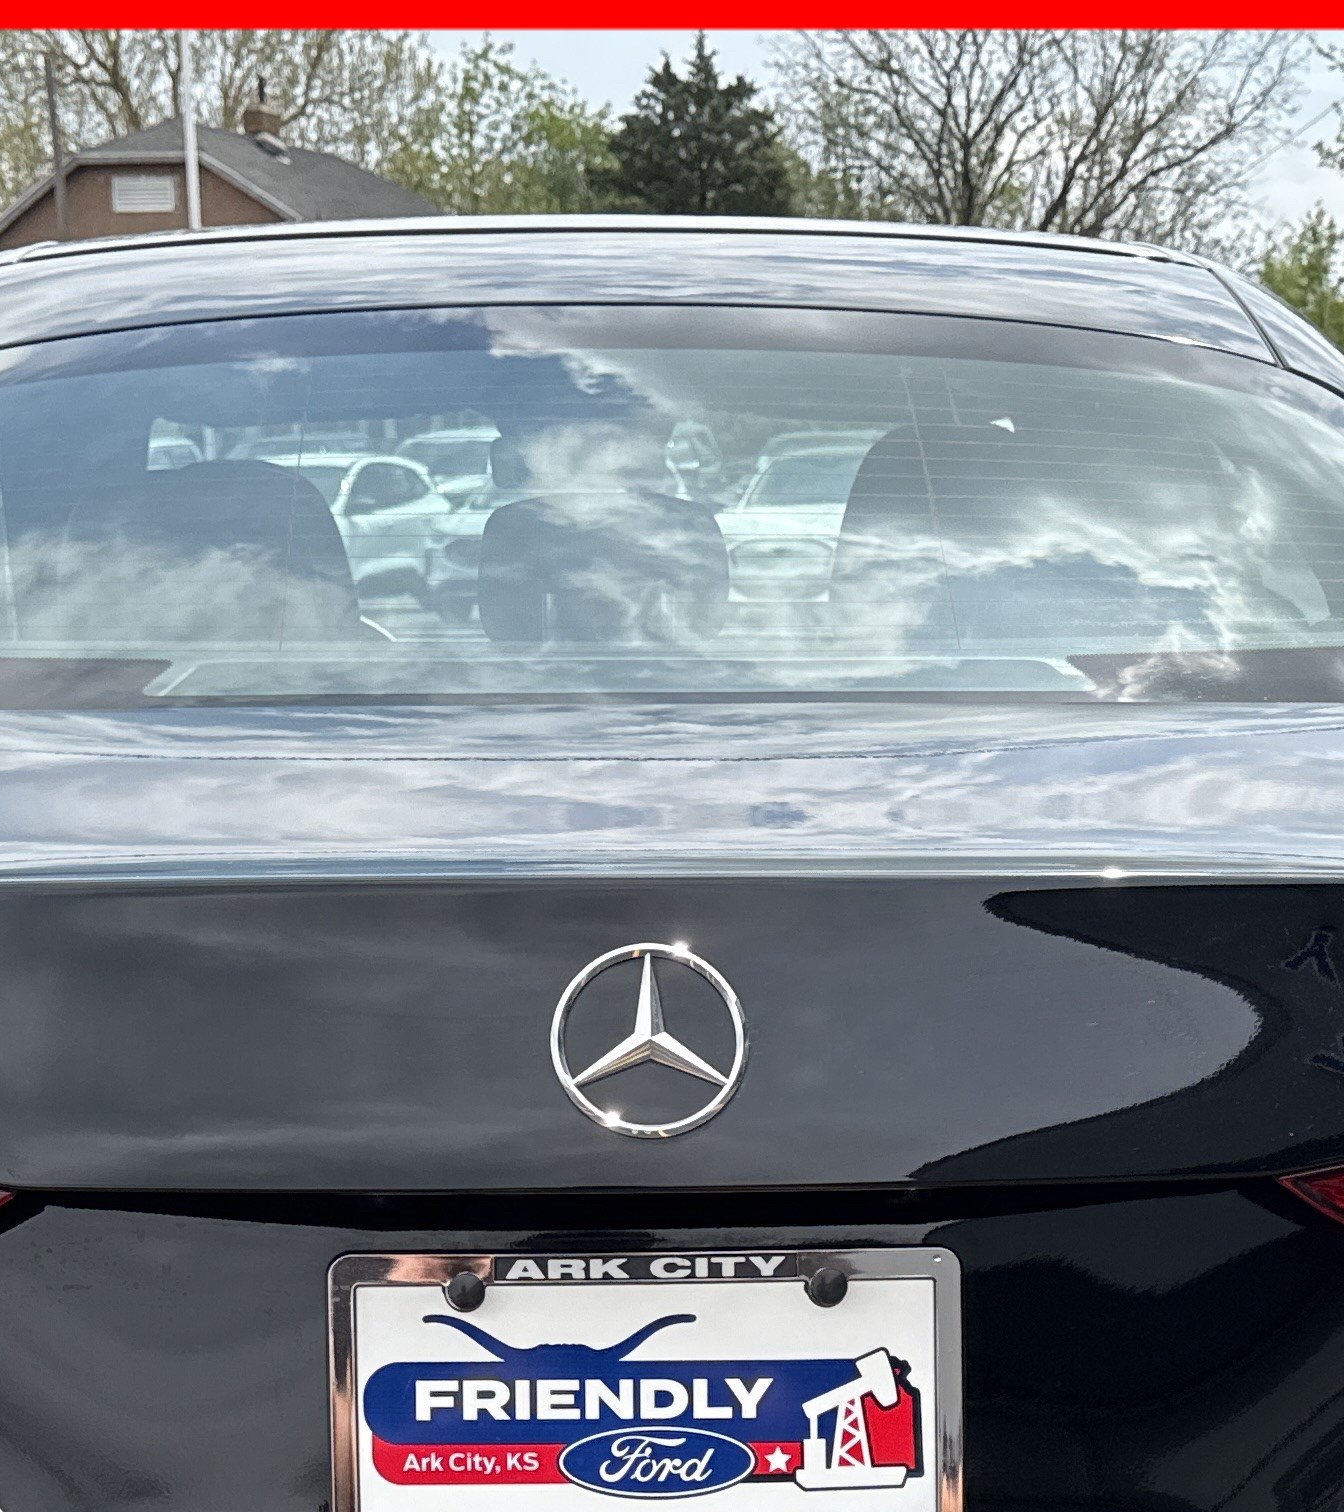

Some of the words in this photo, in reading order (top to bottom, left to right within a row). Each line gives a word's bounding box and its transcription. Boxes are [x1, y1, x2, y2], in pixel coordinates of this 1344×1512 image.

[504, 1257, 631, 1281] ARK
[648, 1255, 787, 1280] CITY
[414, 1377, 775, 1422] FRIENDLY
[402, 1452, 444, 1472] Ark
[447, 1451, 502, 1475] City,
[506, 1451, 540, 1472] KS
[598, 1434, 715, 1483] Ford
